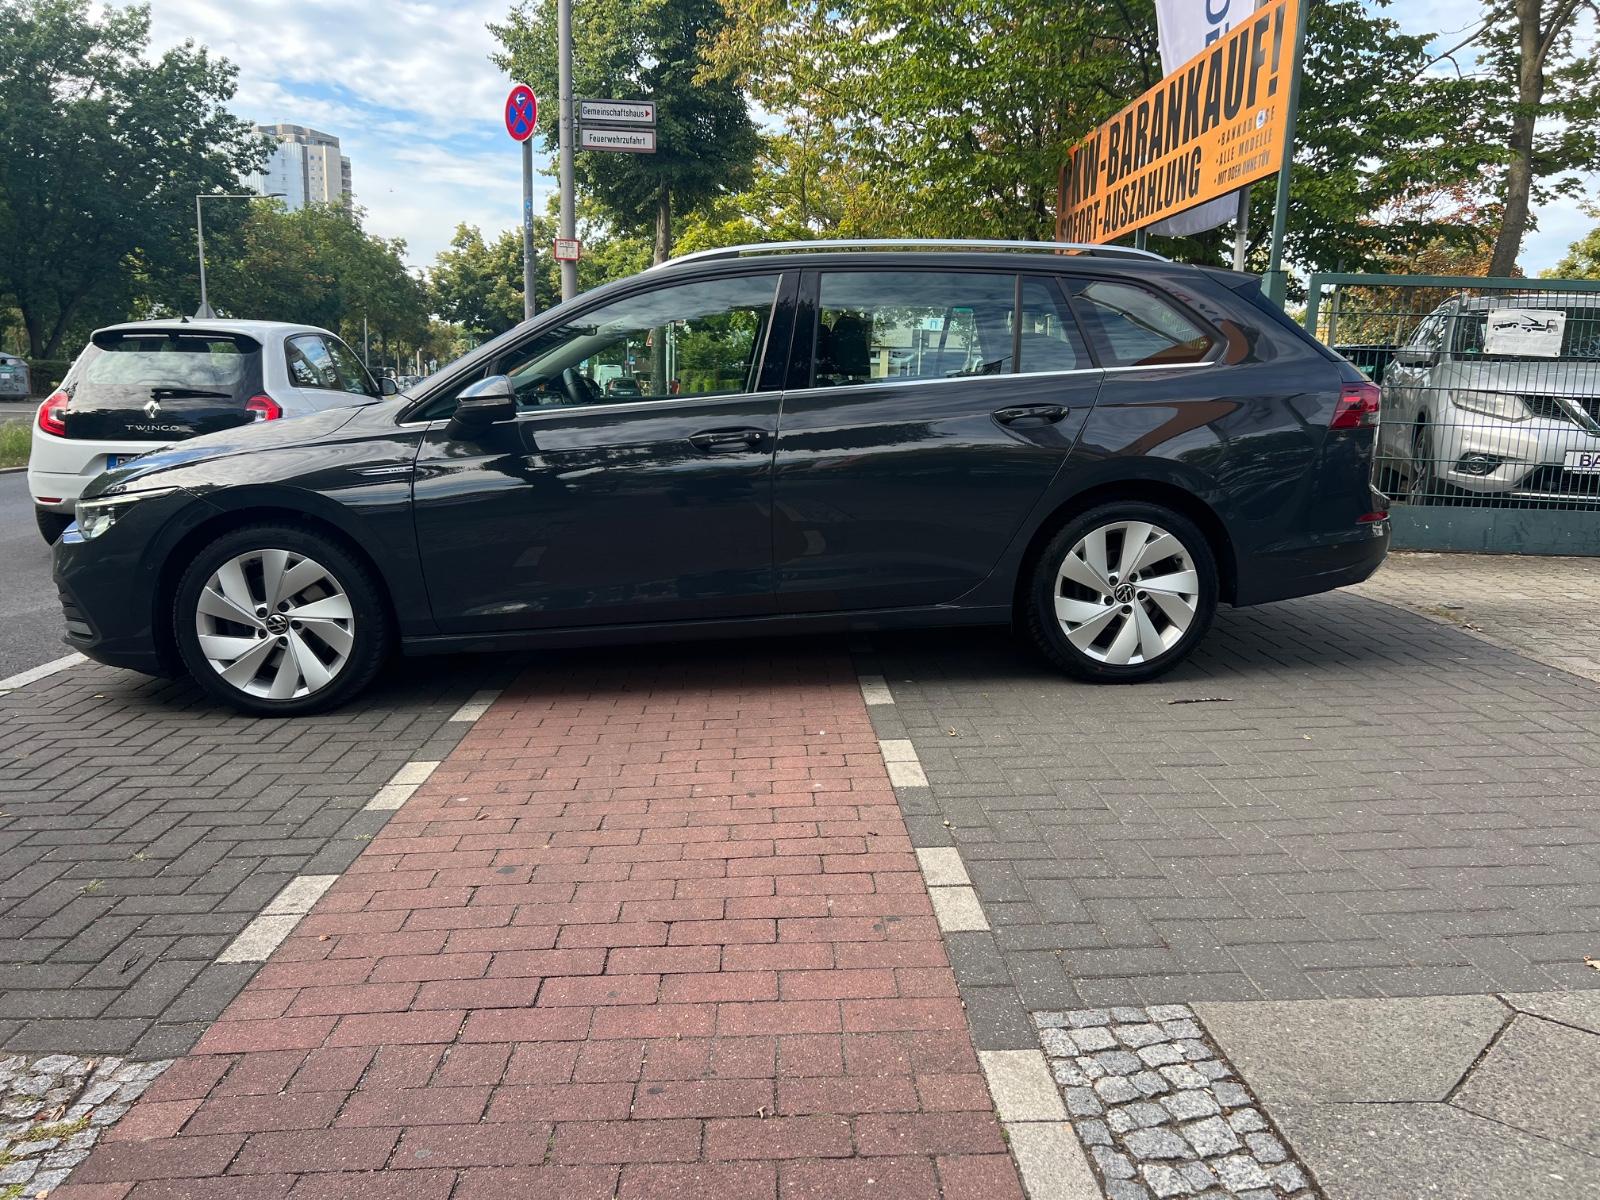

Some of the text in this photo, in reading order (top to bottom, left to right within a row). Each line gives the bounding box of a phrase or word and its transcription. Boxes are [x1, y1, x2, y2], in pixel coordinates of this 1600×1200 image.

[582, 106, 645, 118] Gemeinschaftshaus
[1061, 4, 1286, 213] PKW-BARANKAUF!
[589, 133, 646, 145] Feuerwehrzufahrt
[1218, 146, 1235, 167] ALLE
[1060, 146, 1202, 244] SOFORT-AUSZAHLUNG
